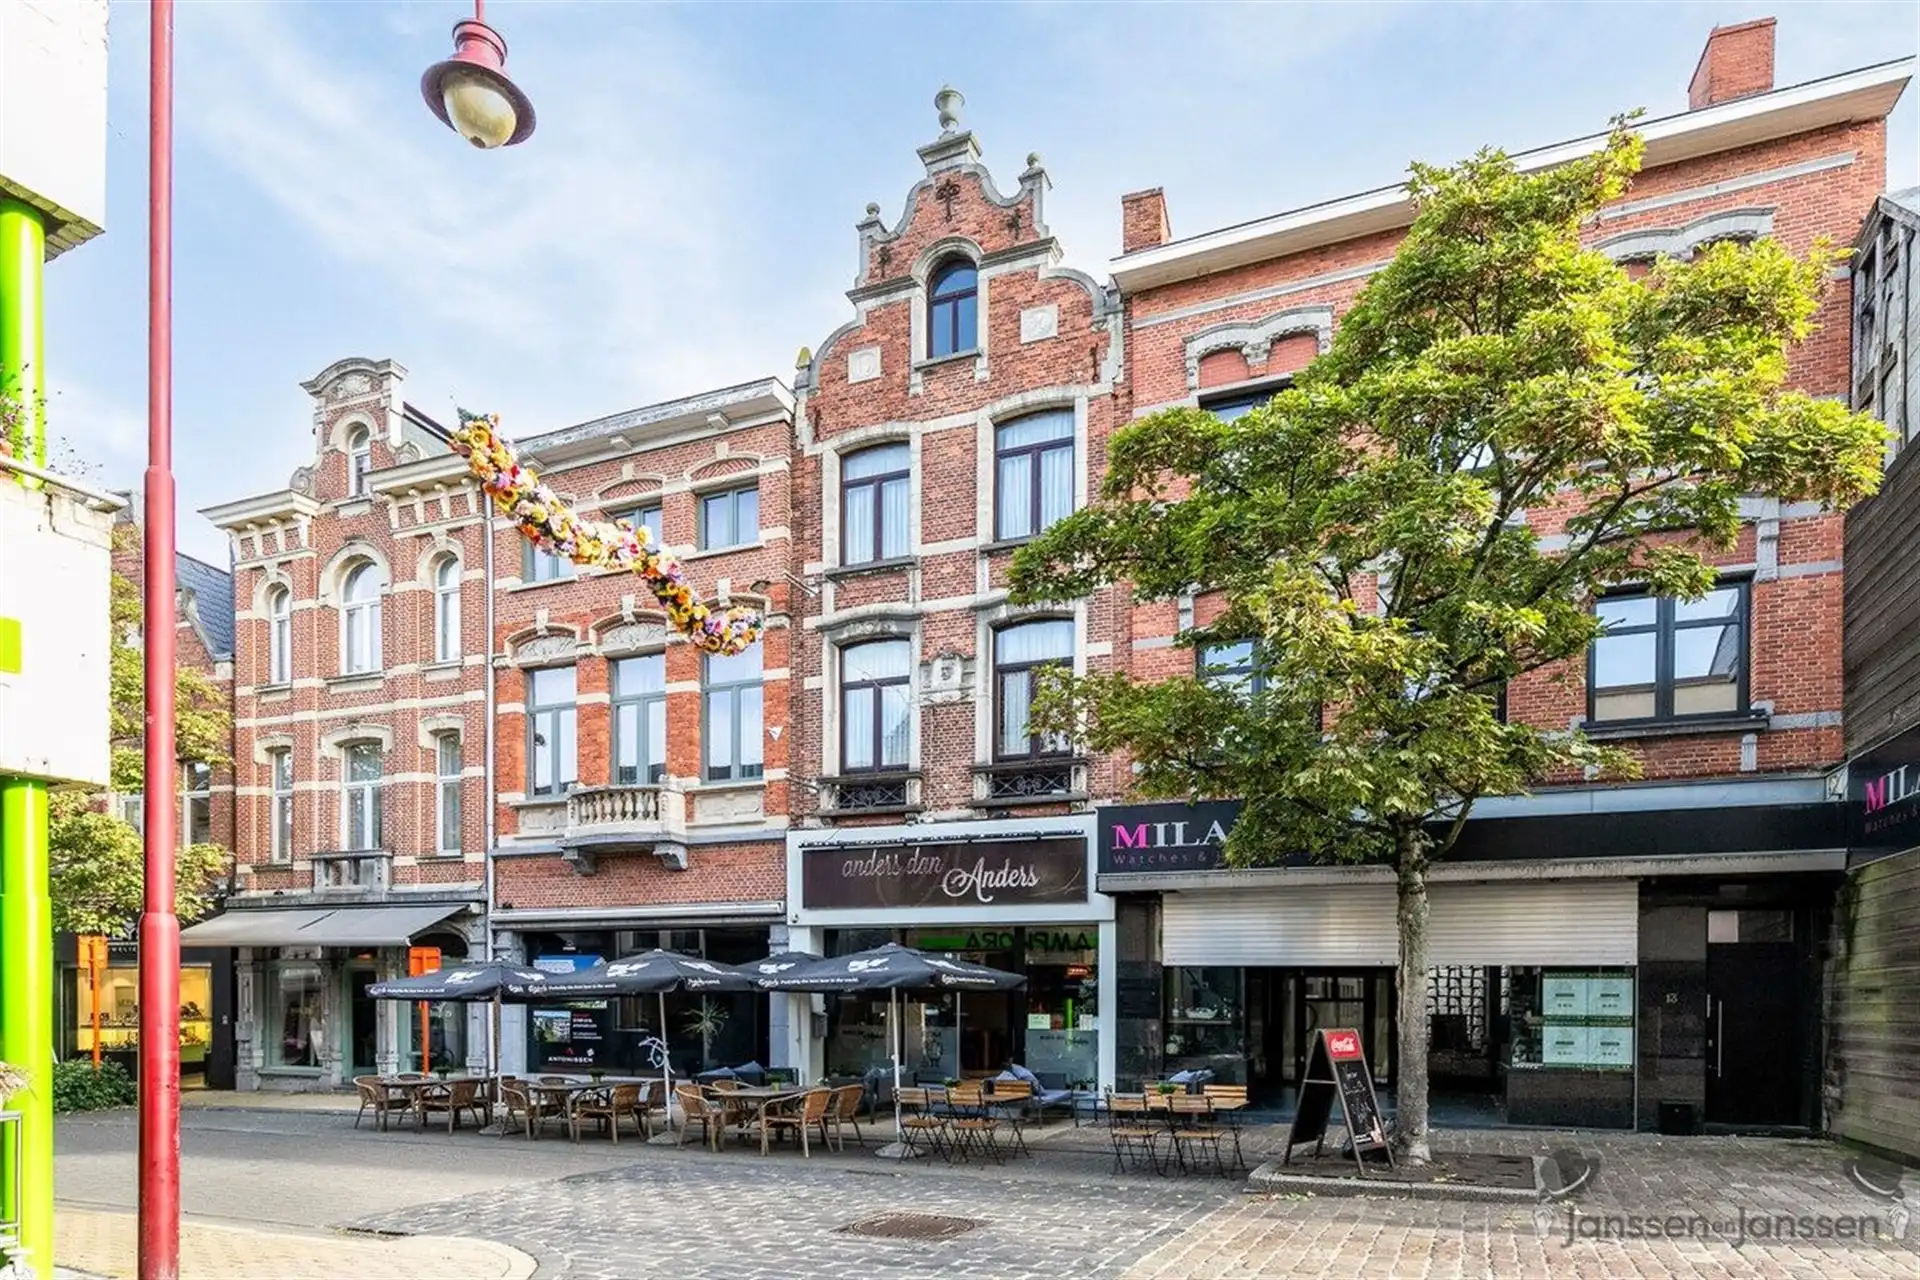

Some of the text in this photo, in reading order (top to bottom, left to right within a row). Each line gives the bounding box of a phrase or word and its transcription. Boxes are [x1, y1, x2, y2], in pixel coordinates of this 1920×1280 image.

[842, 847, 1041, 904] anders dan Anders
[1113, 852, 1194, 866] Watches
